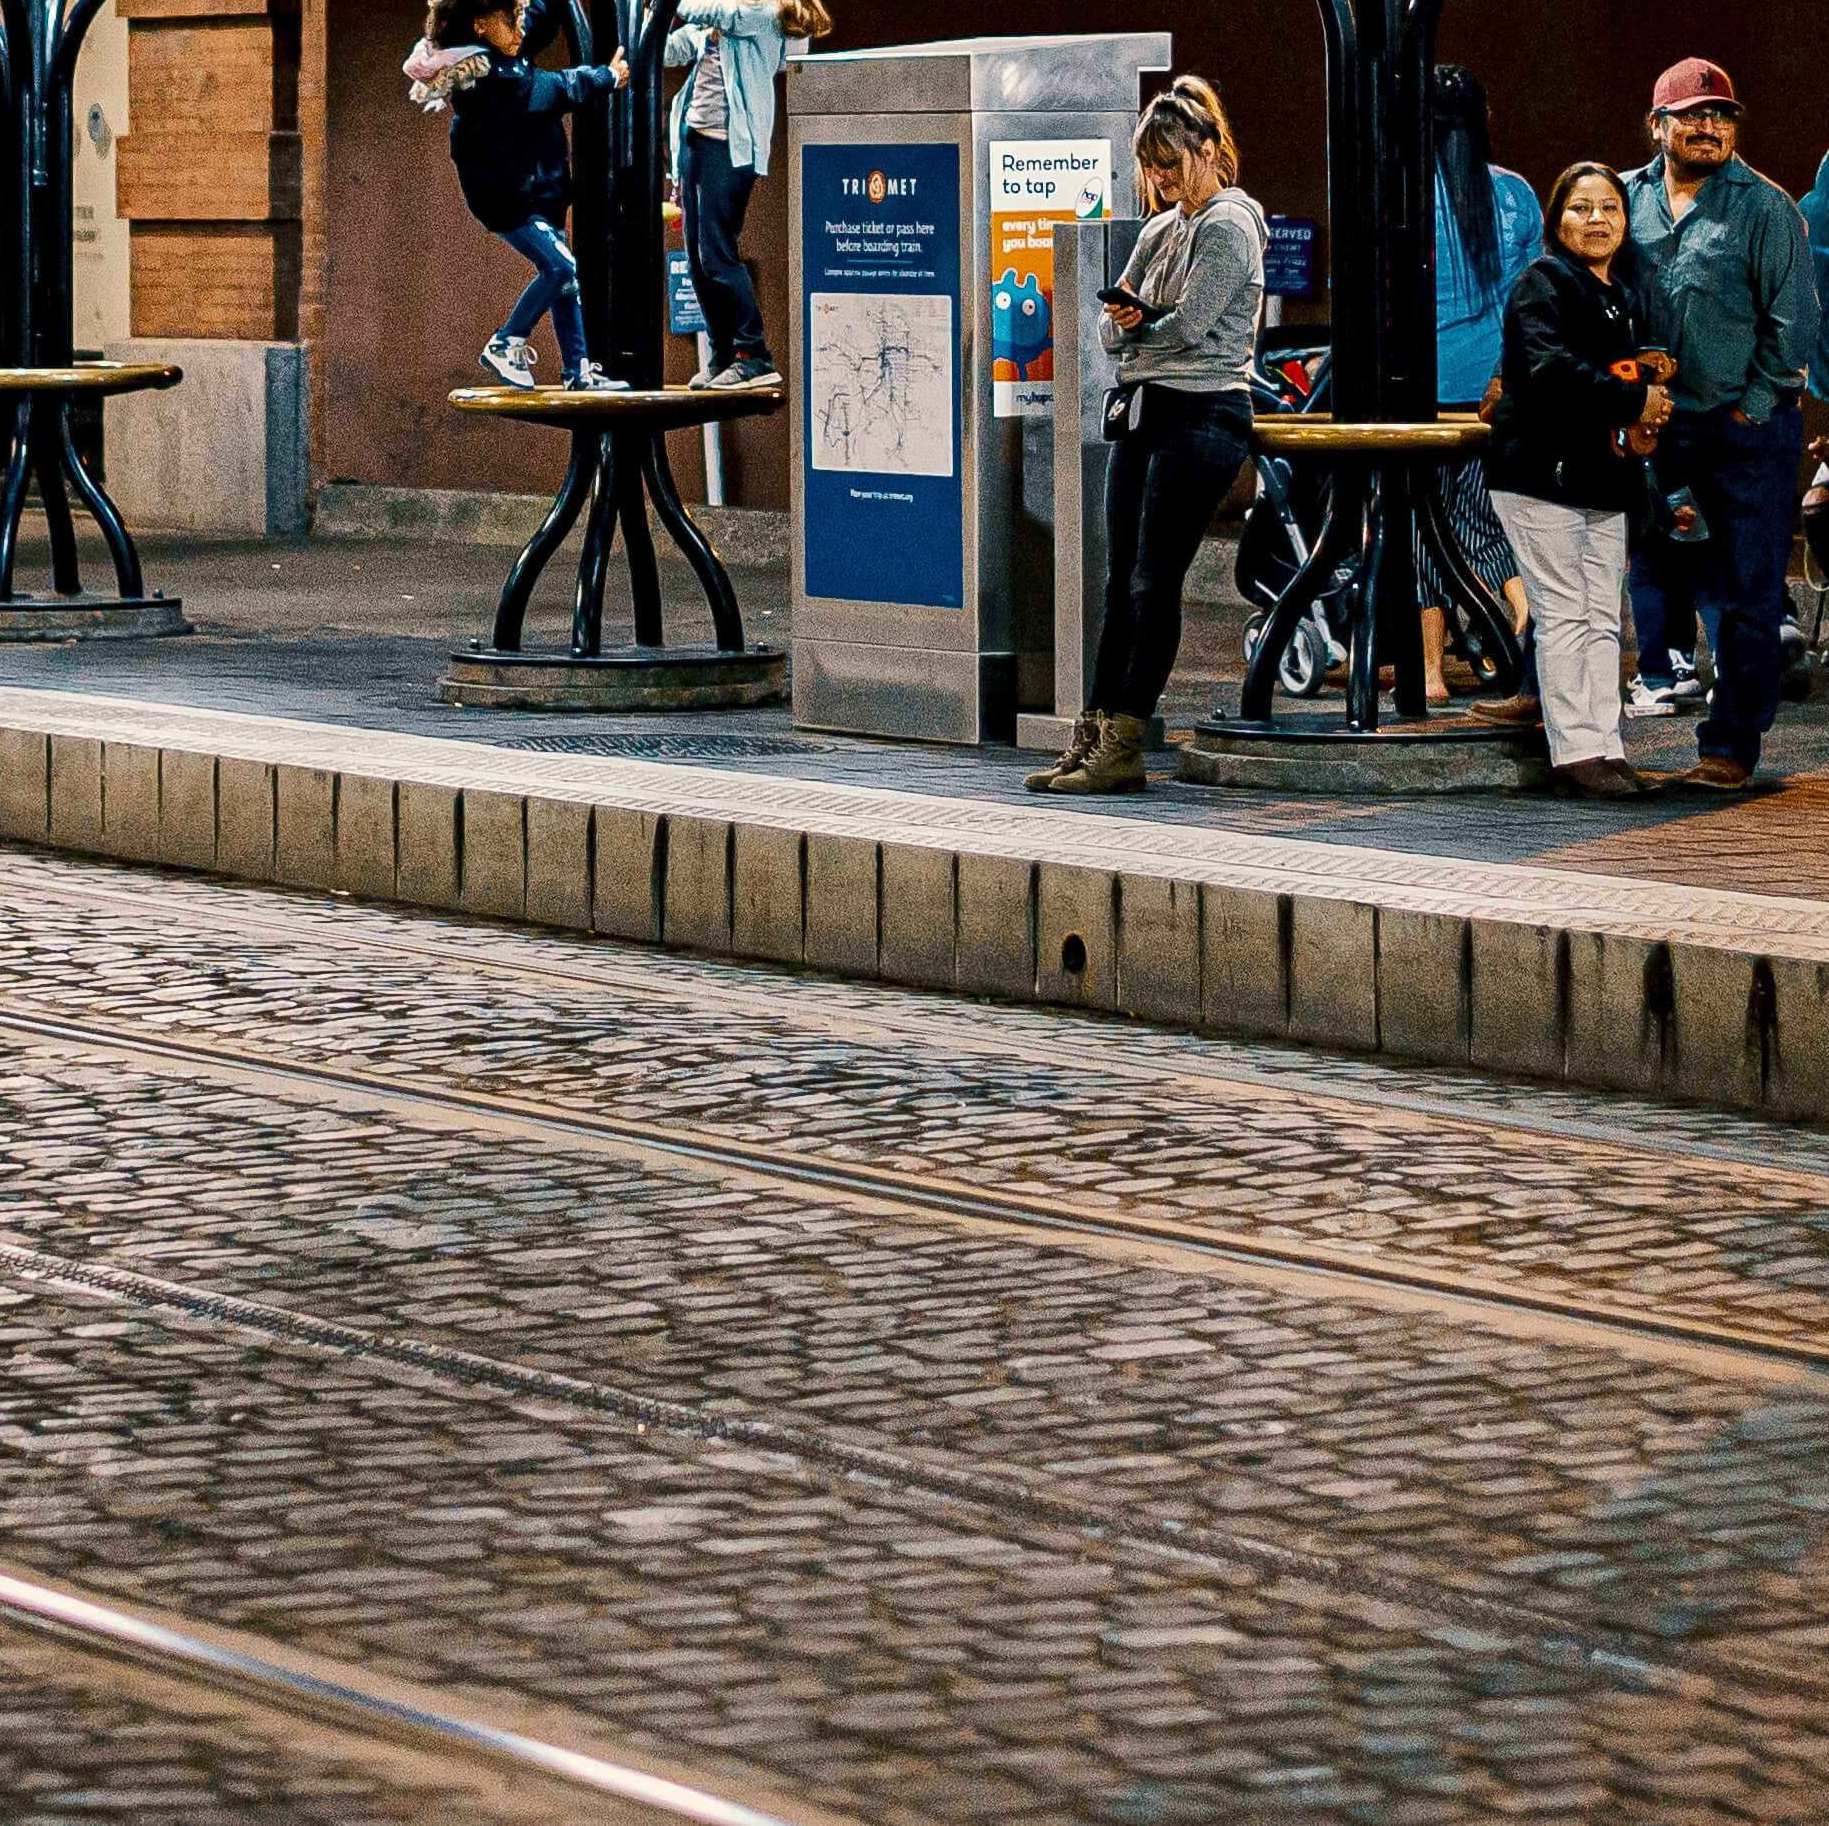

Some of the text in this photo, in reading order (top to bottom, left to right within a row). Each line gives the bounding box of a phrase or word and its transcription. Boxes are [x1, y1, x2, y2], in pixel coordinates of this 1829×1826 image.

[1002, 152, 1099, 172] Remember
[1002, 178, 1056, 199] to tap
[825, 220, 935, 238] Purchase ticket or pass here
[1002, 221, 1036, 235] every
[836, 238, 861, 252] before
[862, 238, 899, 257] boarding
[1002, 238, 1026, 253] you
